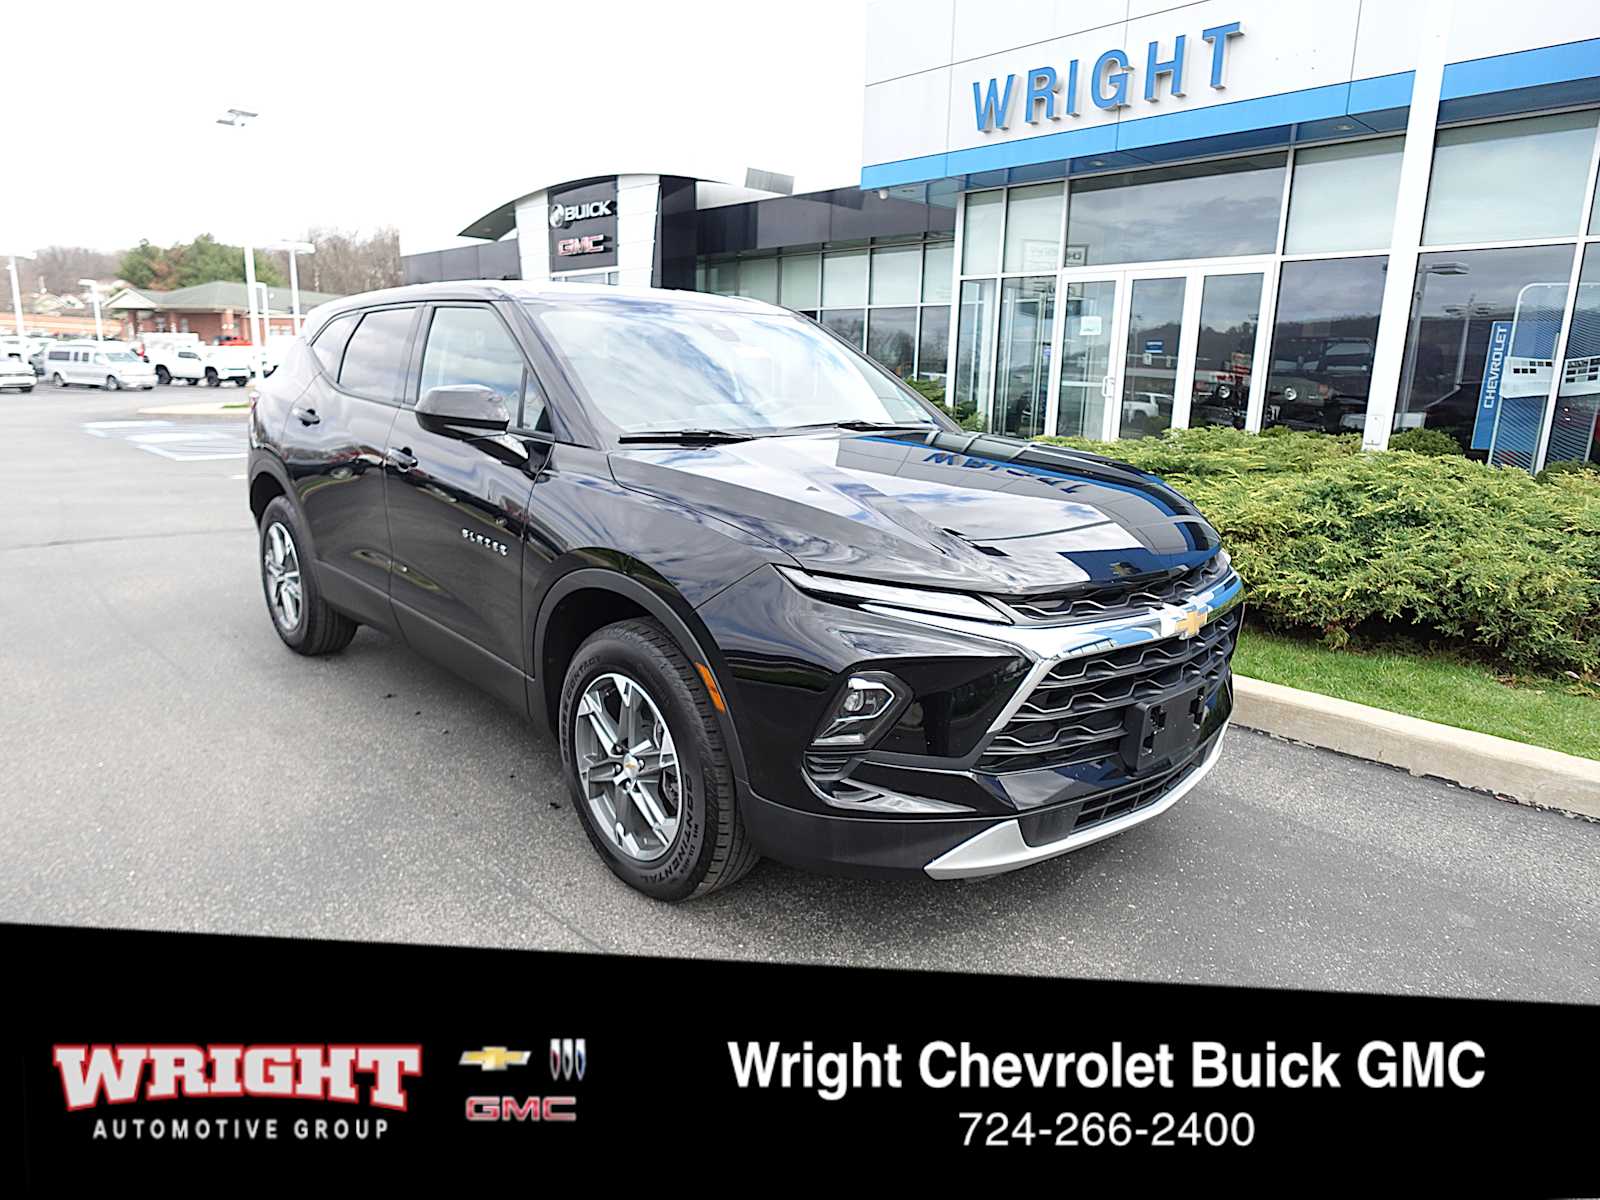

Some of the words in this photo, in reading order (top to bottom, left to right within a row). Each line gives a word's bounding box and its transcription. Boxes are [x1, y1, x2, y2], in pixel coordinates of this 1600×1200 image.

[972, 21, 1243, 132] WRIGHT
[558, 234, 604, 255] GMC
[565, 200, 612, 221] BUICK
[1483, 325, 1508, 409] CHEVROLET
[640, 773, 694, 883] CONTINENTAL
